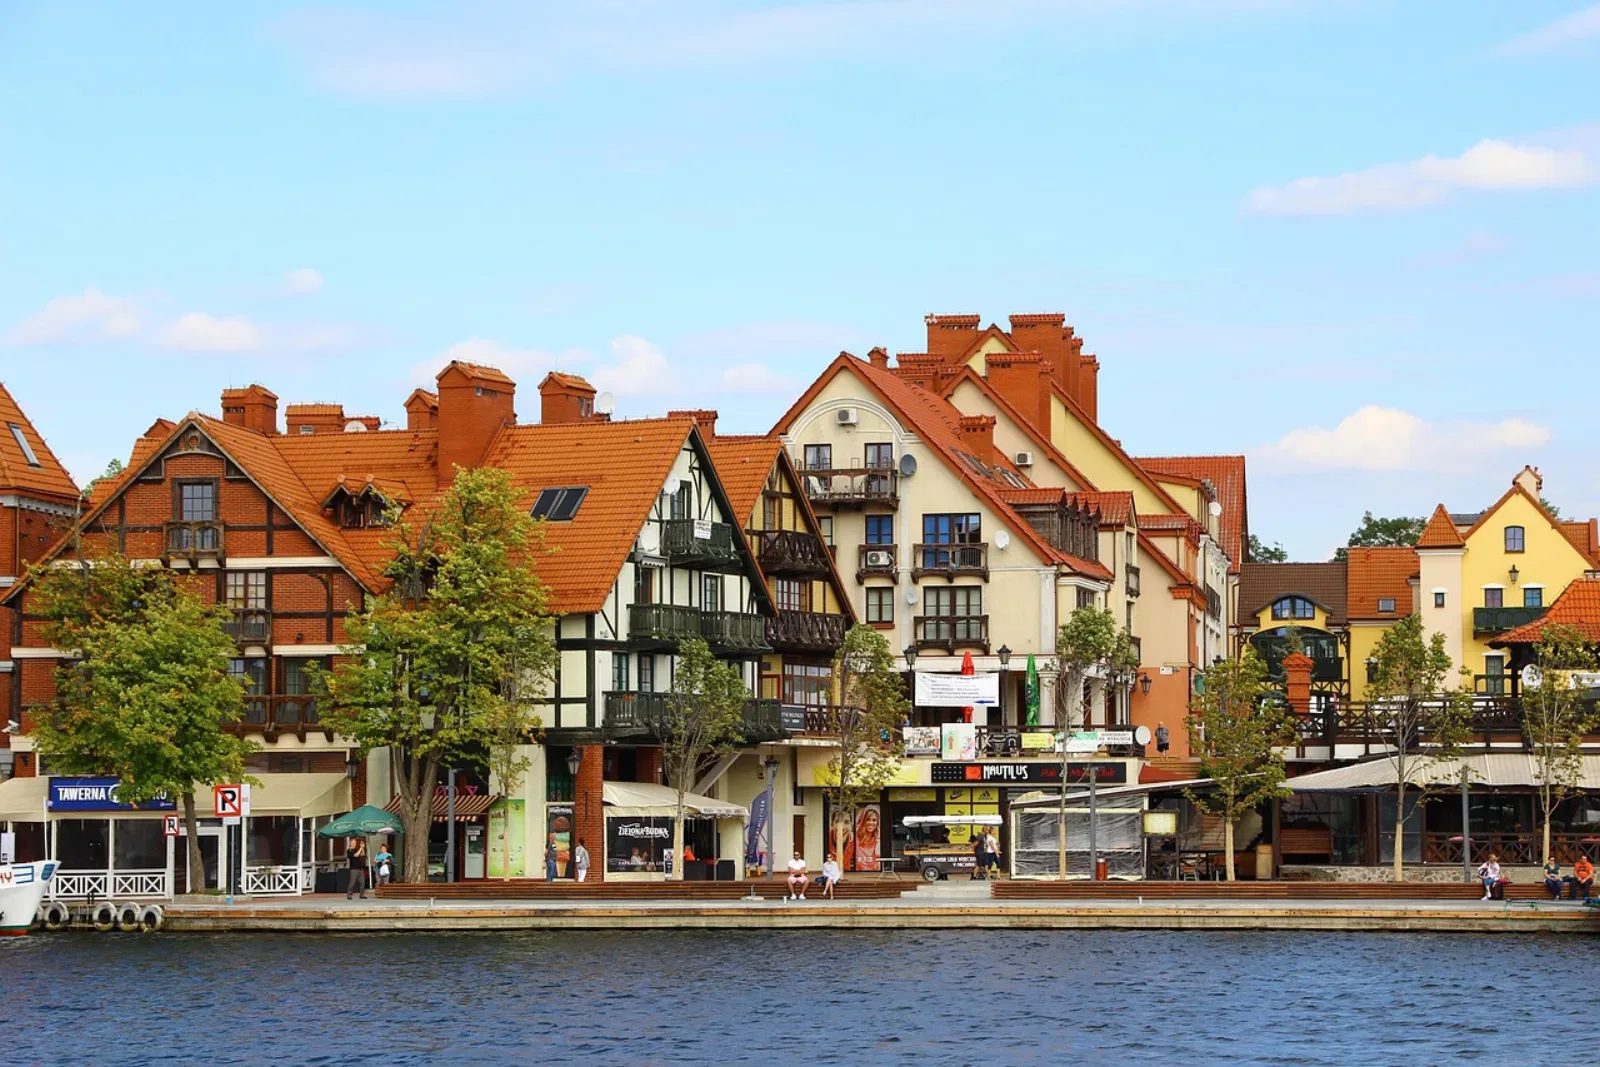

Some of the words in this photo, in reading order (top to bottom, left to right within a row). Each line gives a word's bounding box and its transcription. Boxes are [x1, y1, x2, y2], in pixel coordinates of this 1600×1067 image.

[983, 765, 1028, 779] NAUTILUS
[58, 788, 106, 800] TAWERNA
[618, 826, 645, 836] ZIELONA
[645, 827, 669, 838] BUDKA
